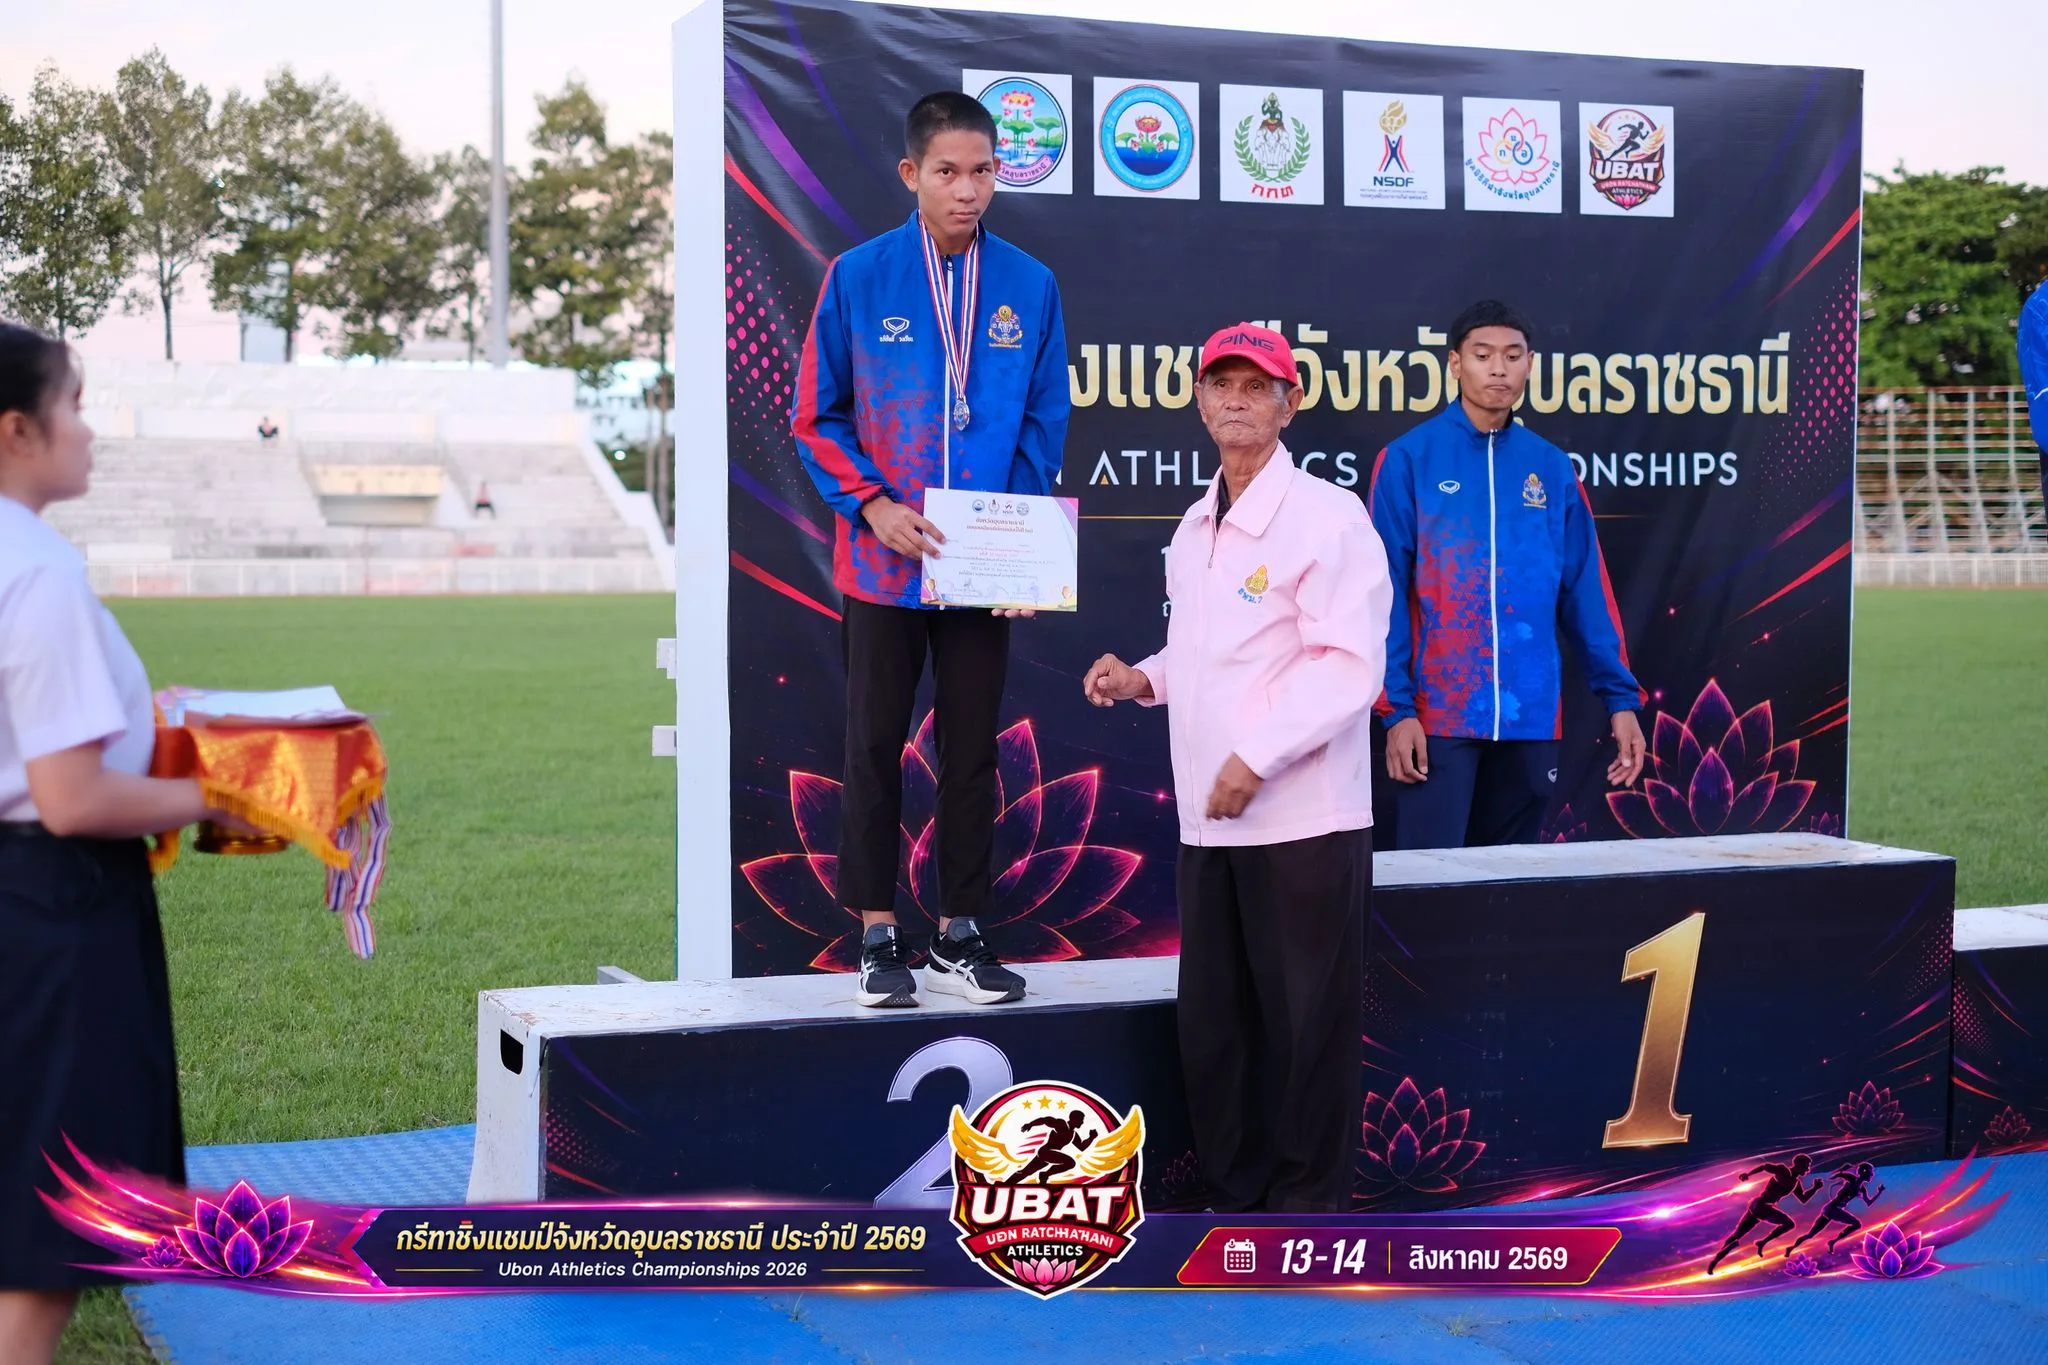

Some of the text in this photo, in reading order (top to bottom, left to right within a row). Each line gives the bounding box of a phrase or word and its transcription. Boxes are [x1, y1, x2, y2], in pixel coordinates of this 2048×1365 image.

[1373, 176, 1414, 187] NSDF
[1595, 160, 1660, 181] UBAT
[1218, 332, 1275, 352] PING
[1089, 450, 1358, 486] ATHLCS
[1602, 912, 1706, 1149] 1
[873, 1036, 1013, 1208] 2
